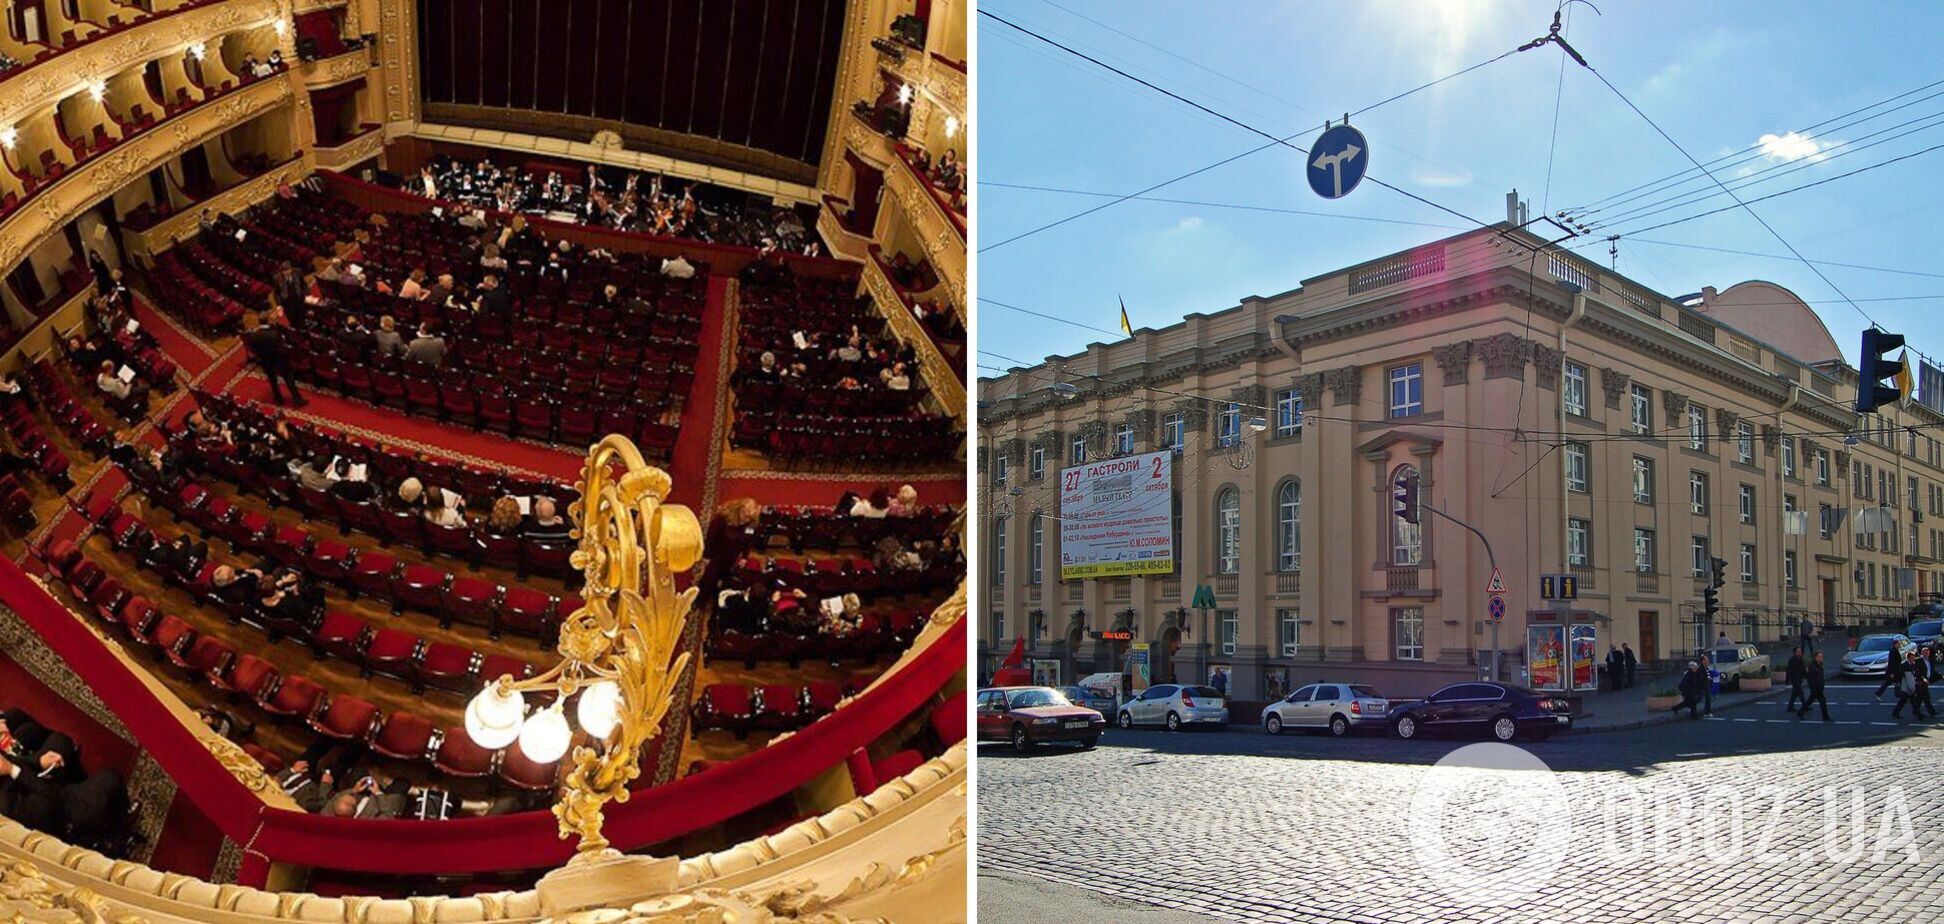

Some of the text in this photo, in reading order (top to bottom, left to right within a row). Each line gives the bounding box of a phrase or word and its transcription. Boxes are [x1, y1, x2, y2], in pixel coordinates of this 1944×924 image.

[1088, 460, 1140, 478] ГАСТРОЛИ
[1152, 457, 1162, 479] 2
[1065, 470, 1080, 492] 27
